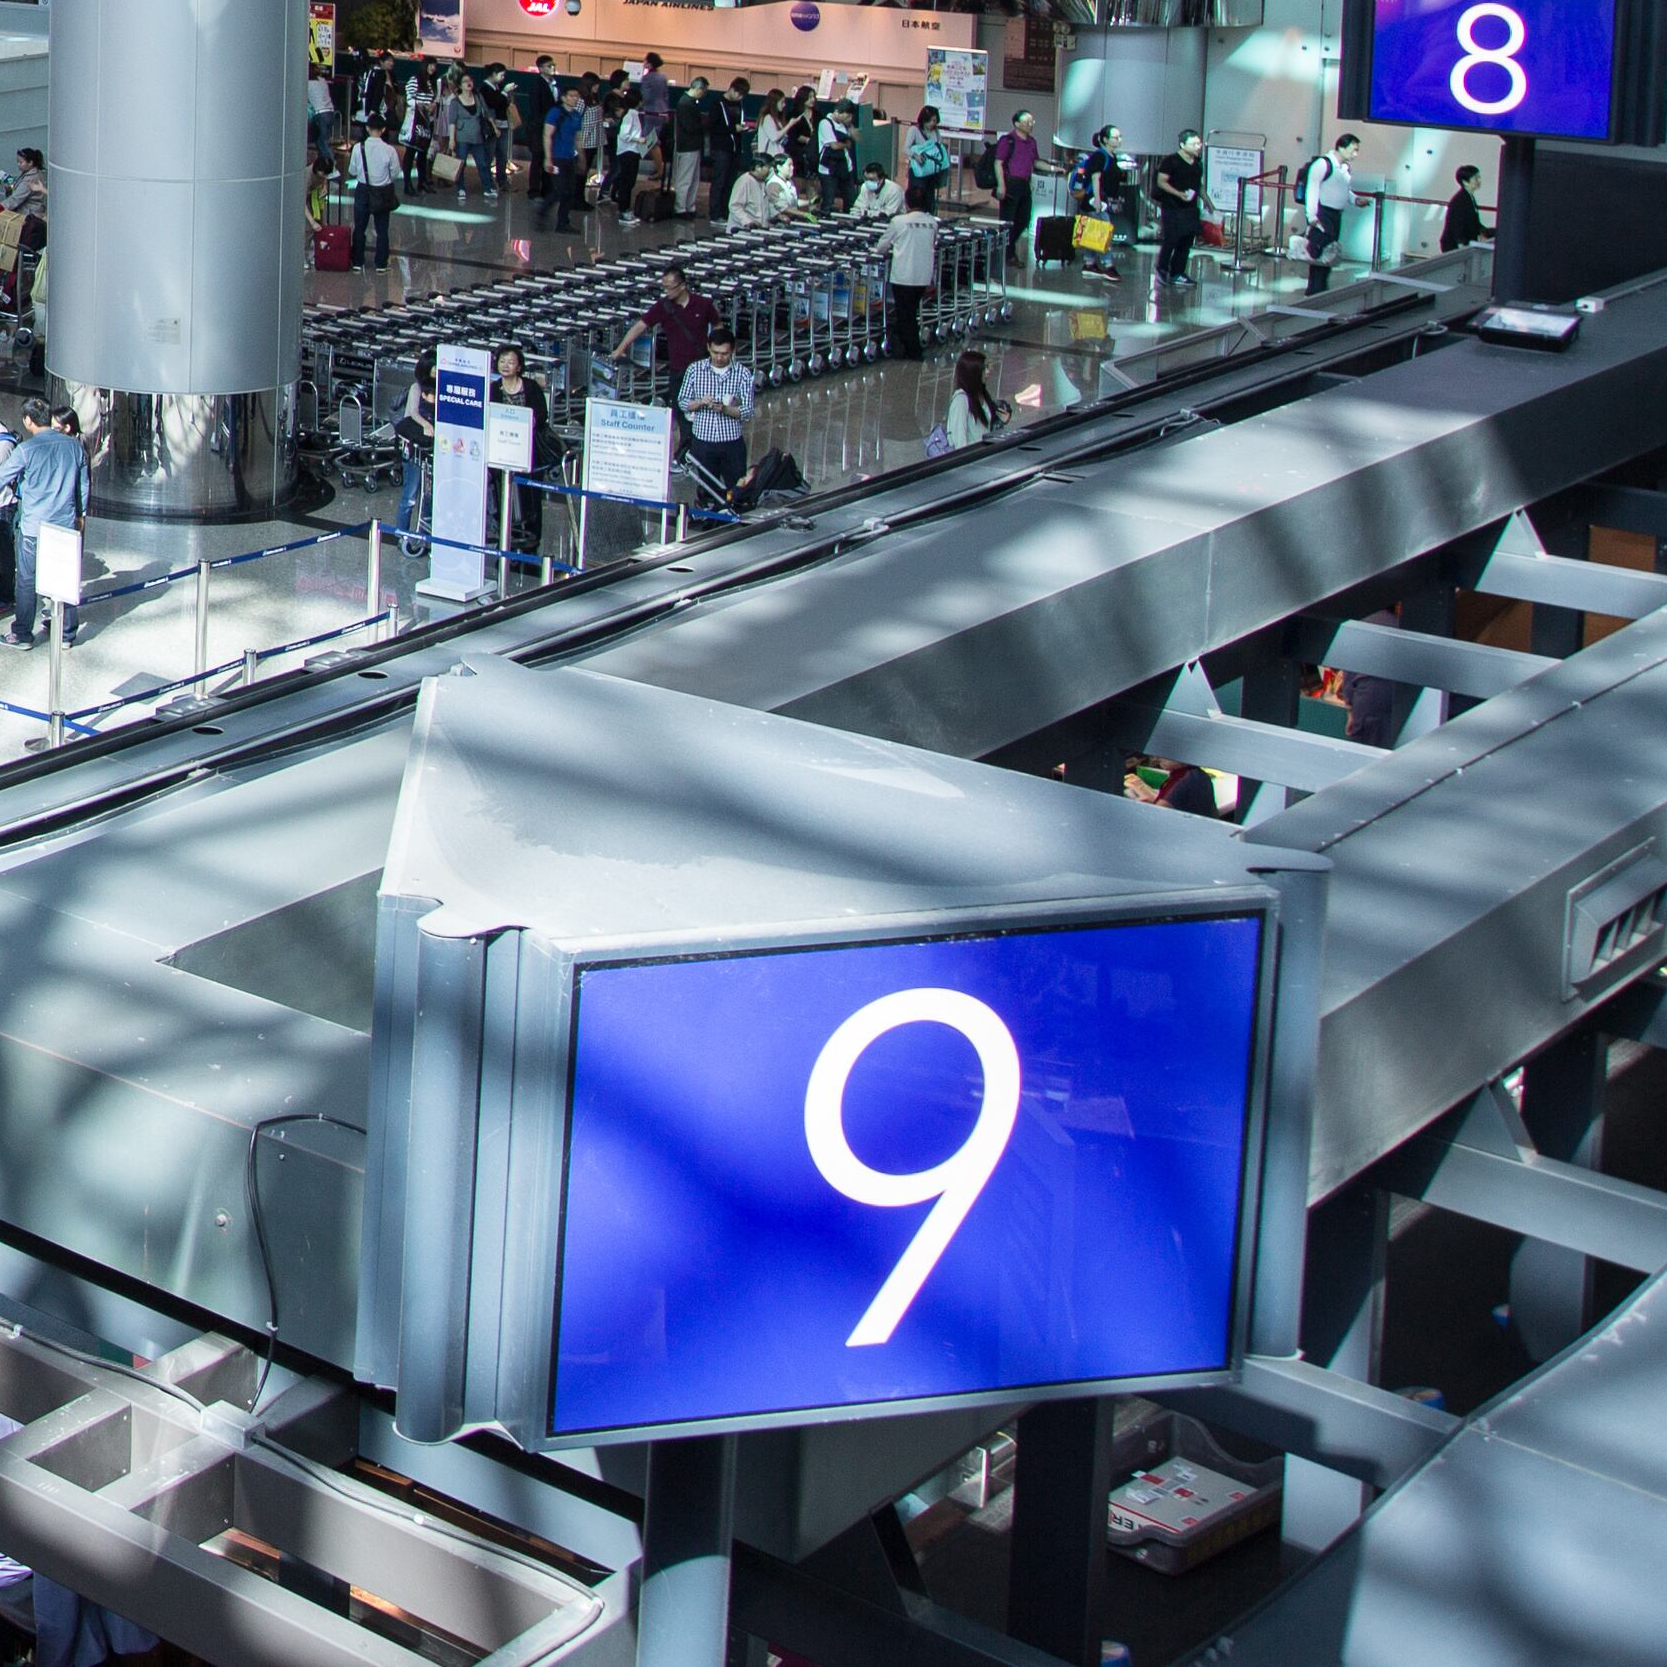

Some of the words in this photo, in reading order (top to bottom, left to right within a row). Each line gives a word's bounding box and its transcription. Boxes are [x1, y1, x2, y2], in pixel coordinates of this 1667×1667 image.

[528, 2, 550, 13] JAL
[791, 12, 820, 20] oneworld
[901, 19, 941, 31] 日本航空
[1449, 2, 1527, 115] 8
[439, 394, 464, 405] SPECIAL
[465, 398, 483, 408] CARE
[601, 418, 620, 428] Staff
[621, 421, 655, 432] Counter
[803, 987, 1021, 1348] 9
